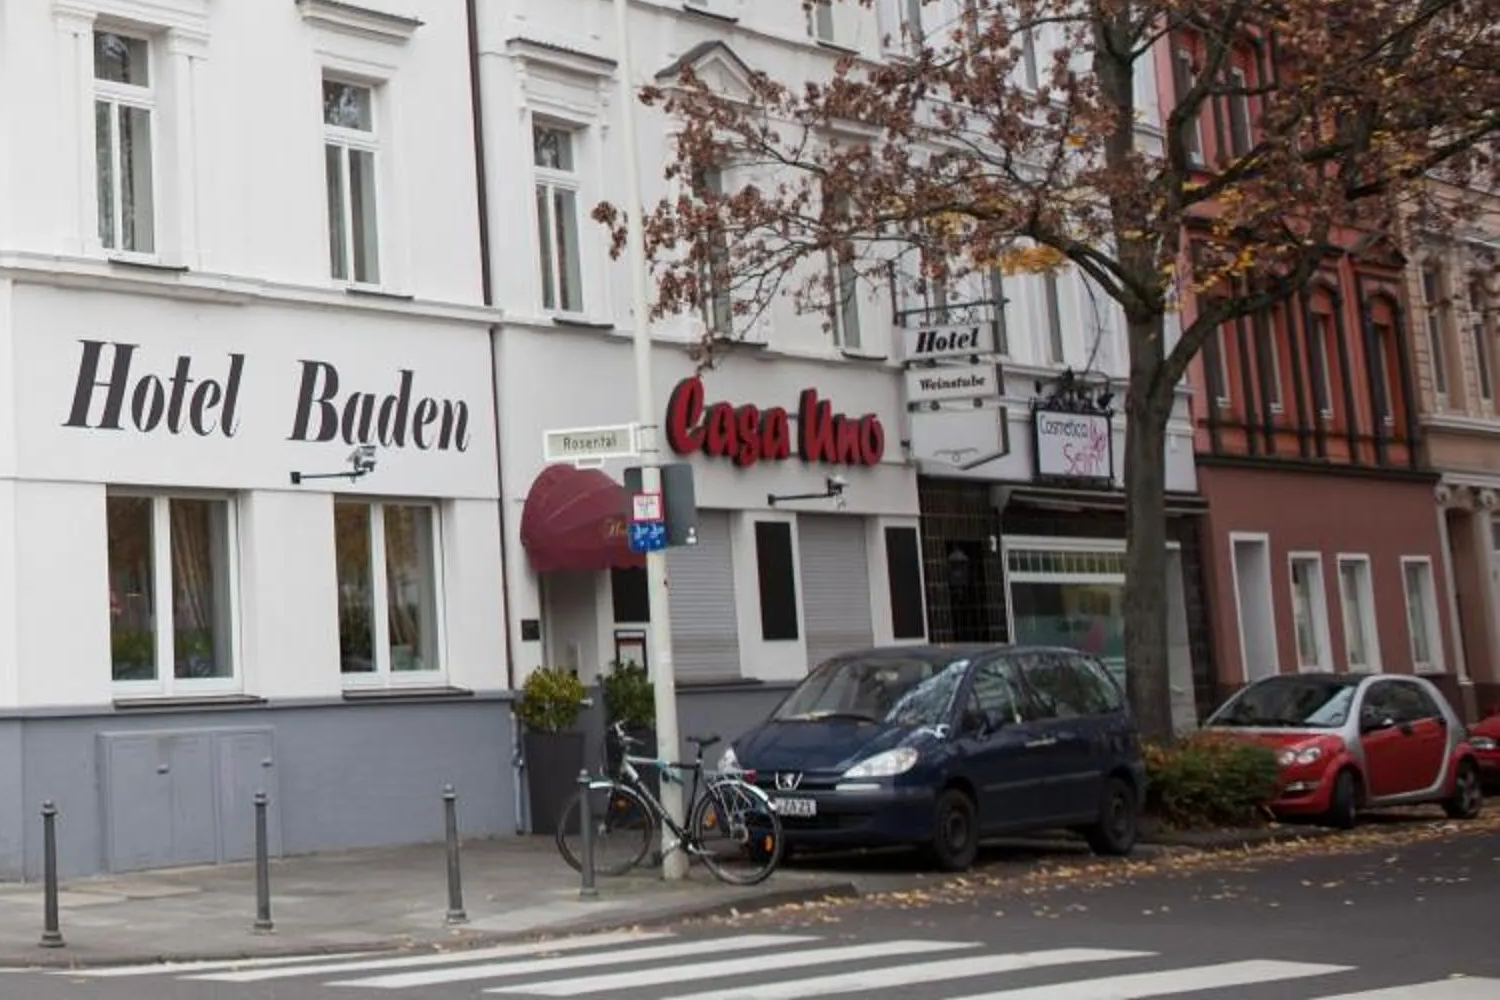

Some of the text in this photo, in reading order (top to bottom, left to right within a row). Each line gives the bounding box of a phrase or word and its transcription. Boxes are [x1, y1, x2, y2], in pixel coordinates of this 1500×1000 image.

[916, 328, 978, 353] Hotel
[60, 339, 471, 452] Hotel Baden
[920, 375, 985, 391] Weinstube
[666, 375, 885, 467] Casa Uno
[563, 433, 617, 451] Rosental
